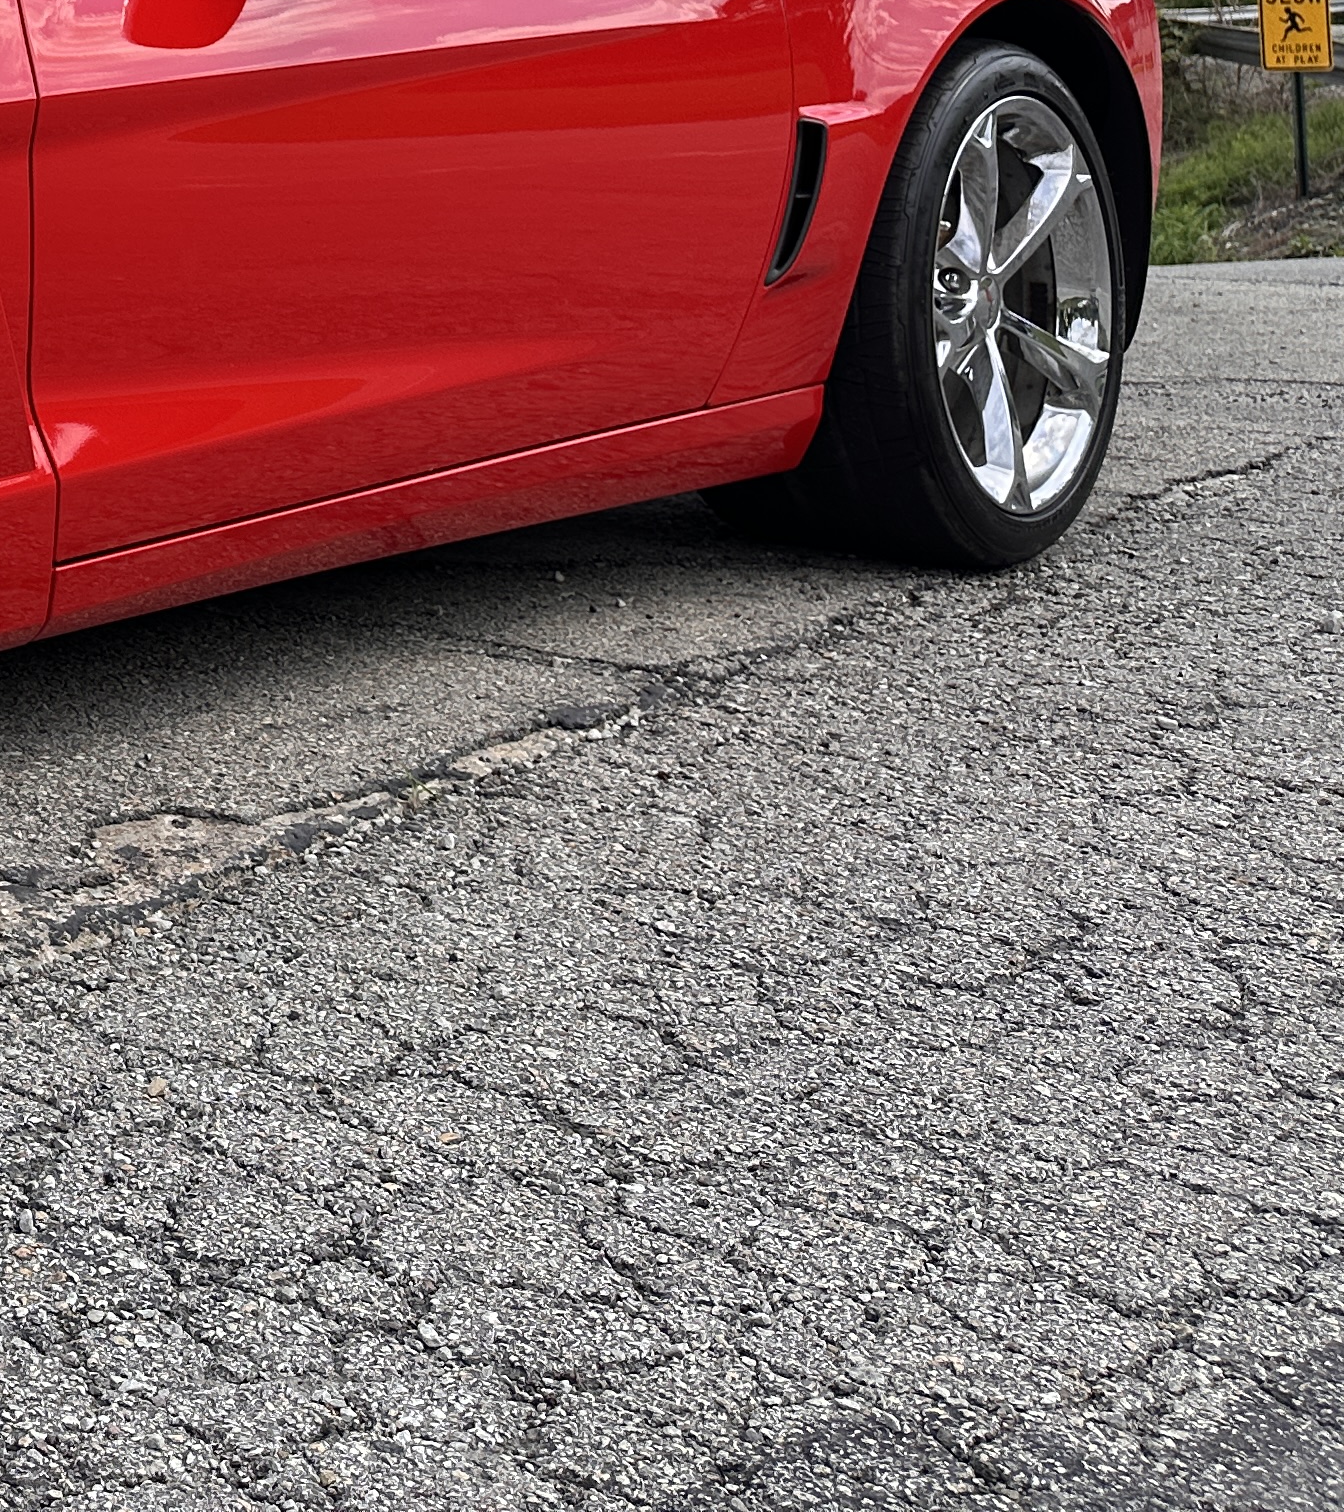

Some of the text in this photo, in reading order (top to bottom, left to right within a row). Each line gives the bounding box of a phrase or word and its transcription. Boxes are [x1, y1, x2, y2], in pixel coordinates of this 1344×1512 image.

[1271, 43, 1321, 54] CHILDREN
[1275, 54, 1320, 65] AT PLAY
